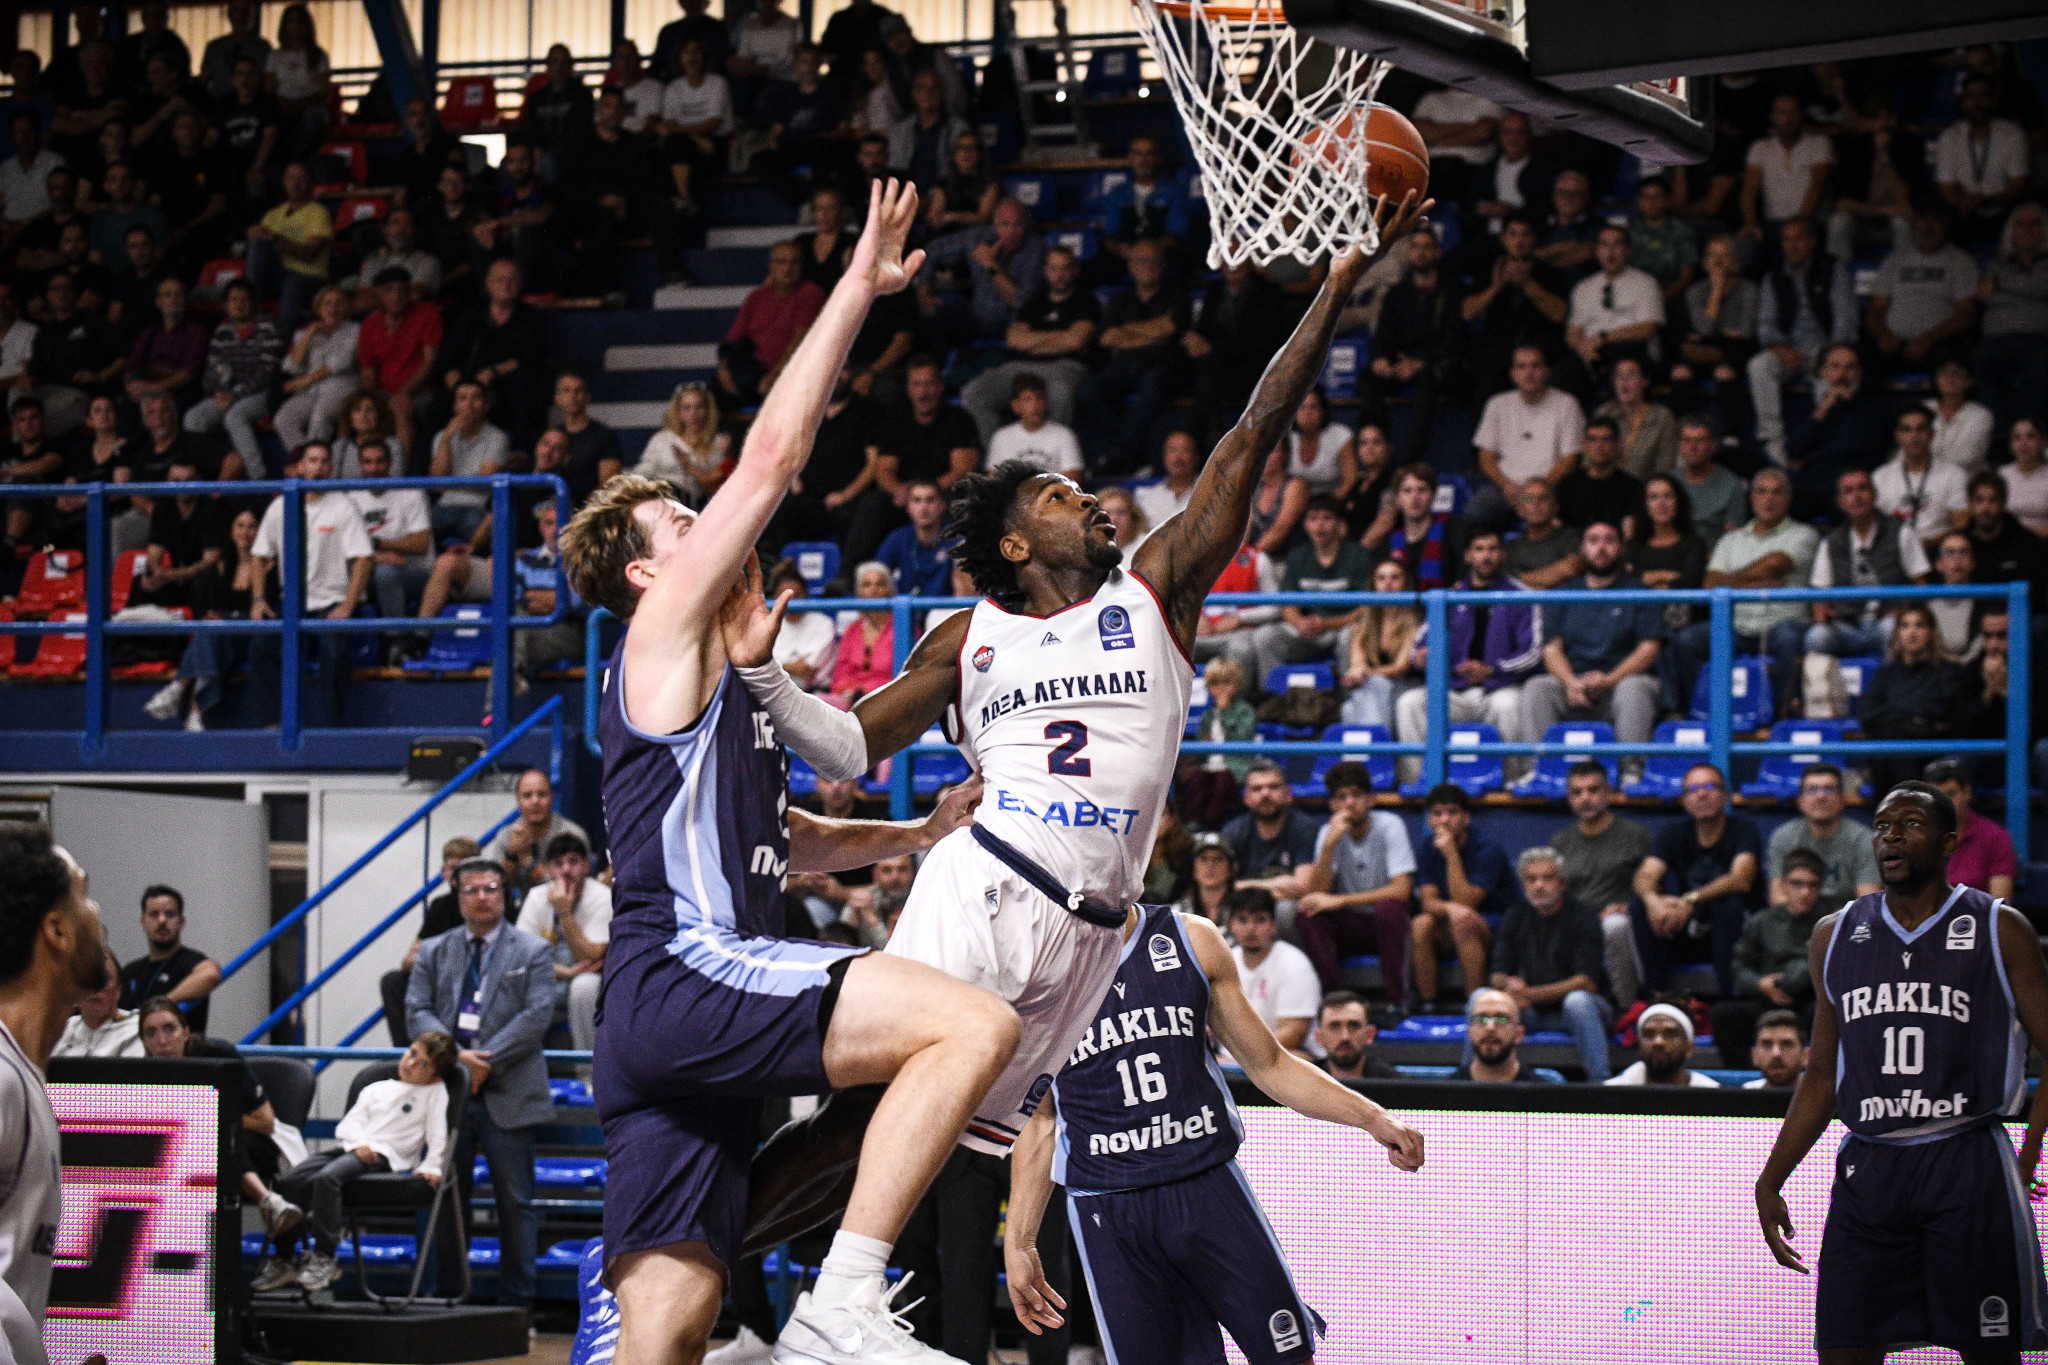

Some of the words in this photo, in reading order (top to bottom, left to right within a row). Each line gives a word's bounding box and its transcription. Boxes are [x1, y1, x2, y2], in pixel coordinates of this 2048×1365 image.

[1043, 720, 1092, 778] 2
[1841, 981, 1971, 1024] IRAKLIS
[1881, 1026, 1925, 1075] 10
[1116, 1052, 1169, 1108] 16
[1089, 1105, 1219, 1156] novibet
